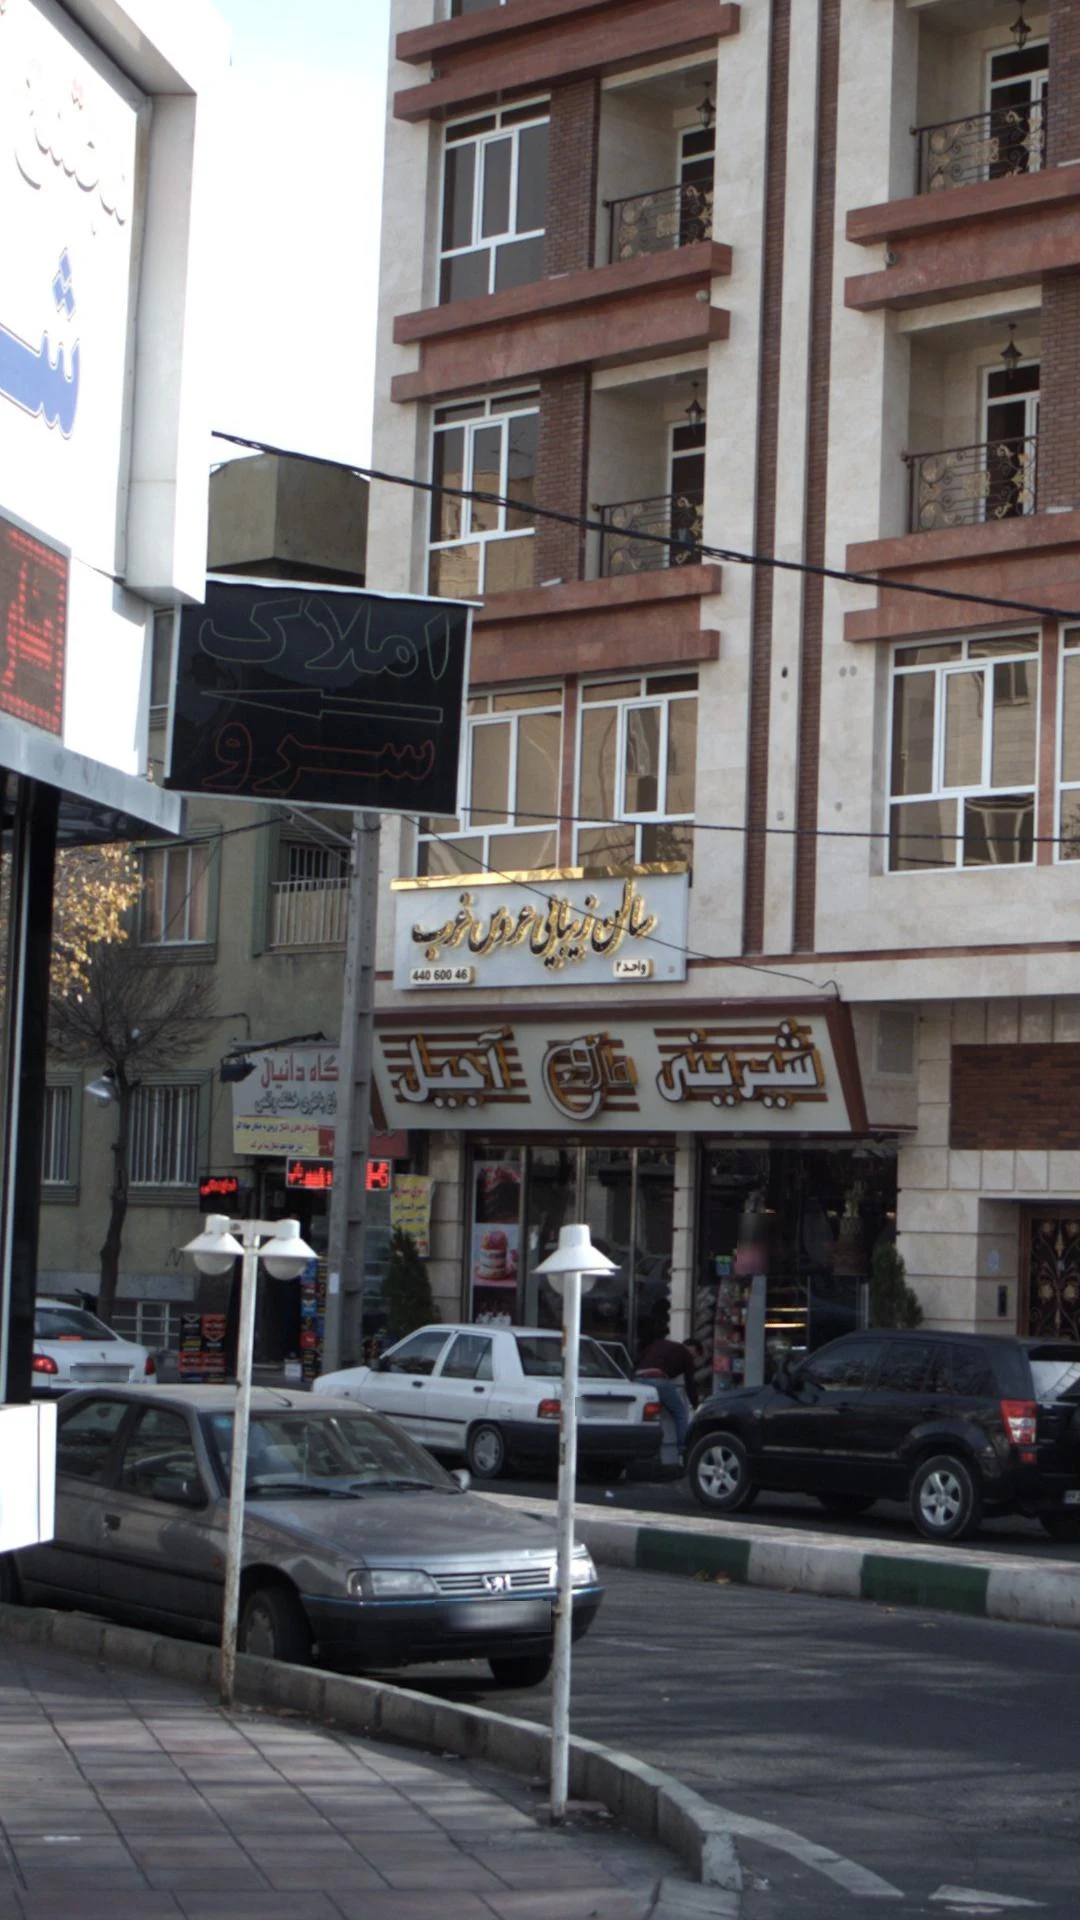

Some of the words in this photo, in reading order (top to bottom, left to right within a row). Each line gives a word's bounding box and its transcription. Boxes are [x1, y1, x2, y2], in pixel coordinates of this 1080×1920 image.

[200, 597, 449, 680] املاک
[412, 891, 481, 961] غرب
[468, 905, 536, 955] عروس
[591, 877, 656, 956] سالن
[412, 969, 432, 981] 440
[433, 969, 453, 980] 600
[455, 968, 468, 979] 46
[623, 960, 646, 975] واحد
[398, 1026, 513, 1108] آجیل
[655, 1020, 826, 1103] شیرینی
